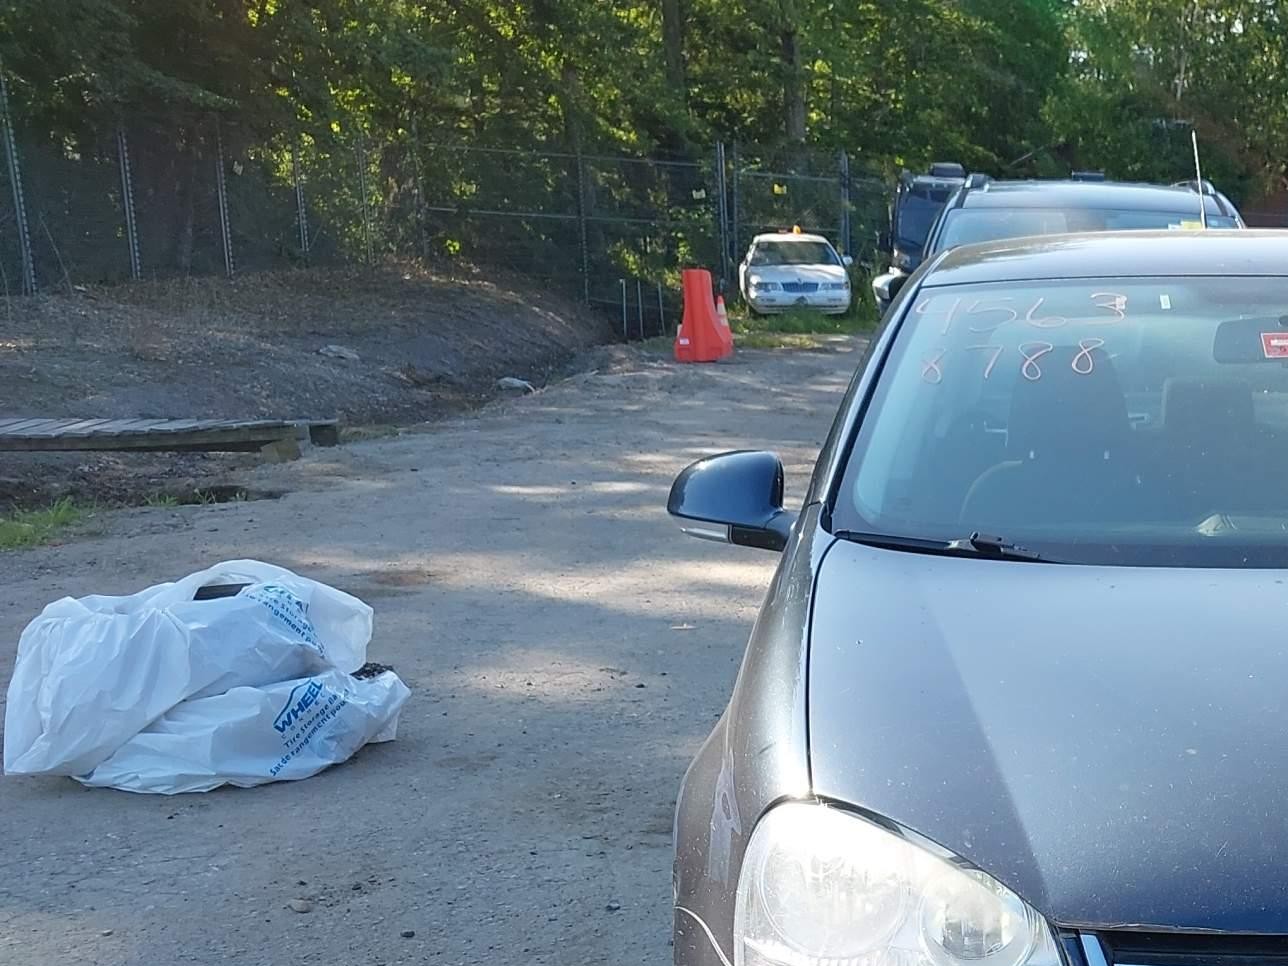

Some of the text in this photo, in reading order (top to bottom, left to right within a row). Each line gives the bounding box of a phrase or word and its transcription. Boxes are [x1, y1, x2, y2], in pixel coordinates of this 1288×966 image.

[915, 291, 1128, 337] 4563
[920, 337, 1105, 384] 8788
[273, 680, 323, 734] WHEEL
[283, 732, 301, 749] Tire
[299, 703, 330, 735] Storage
[290, 715, 331, 757] rangement
